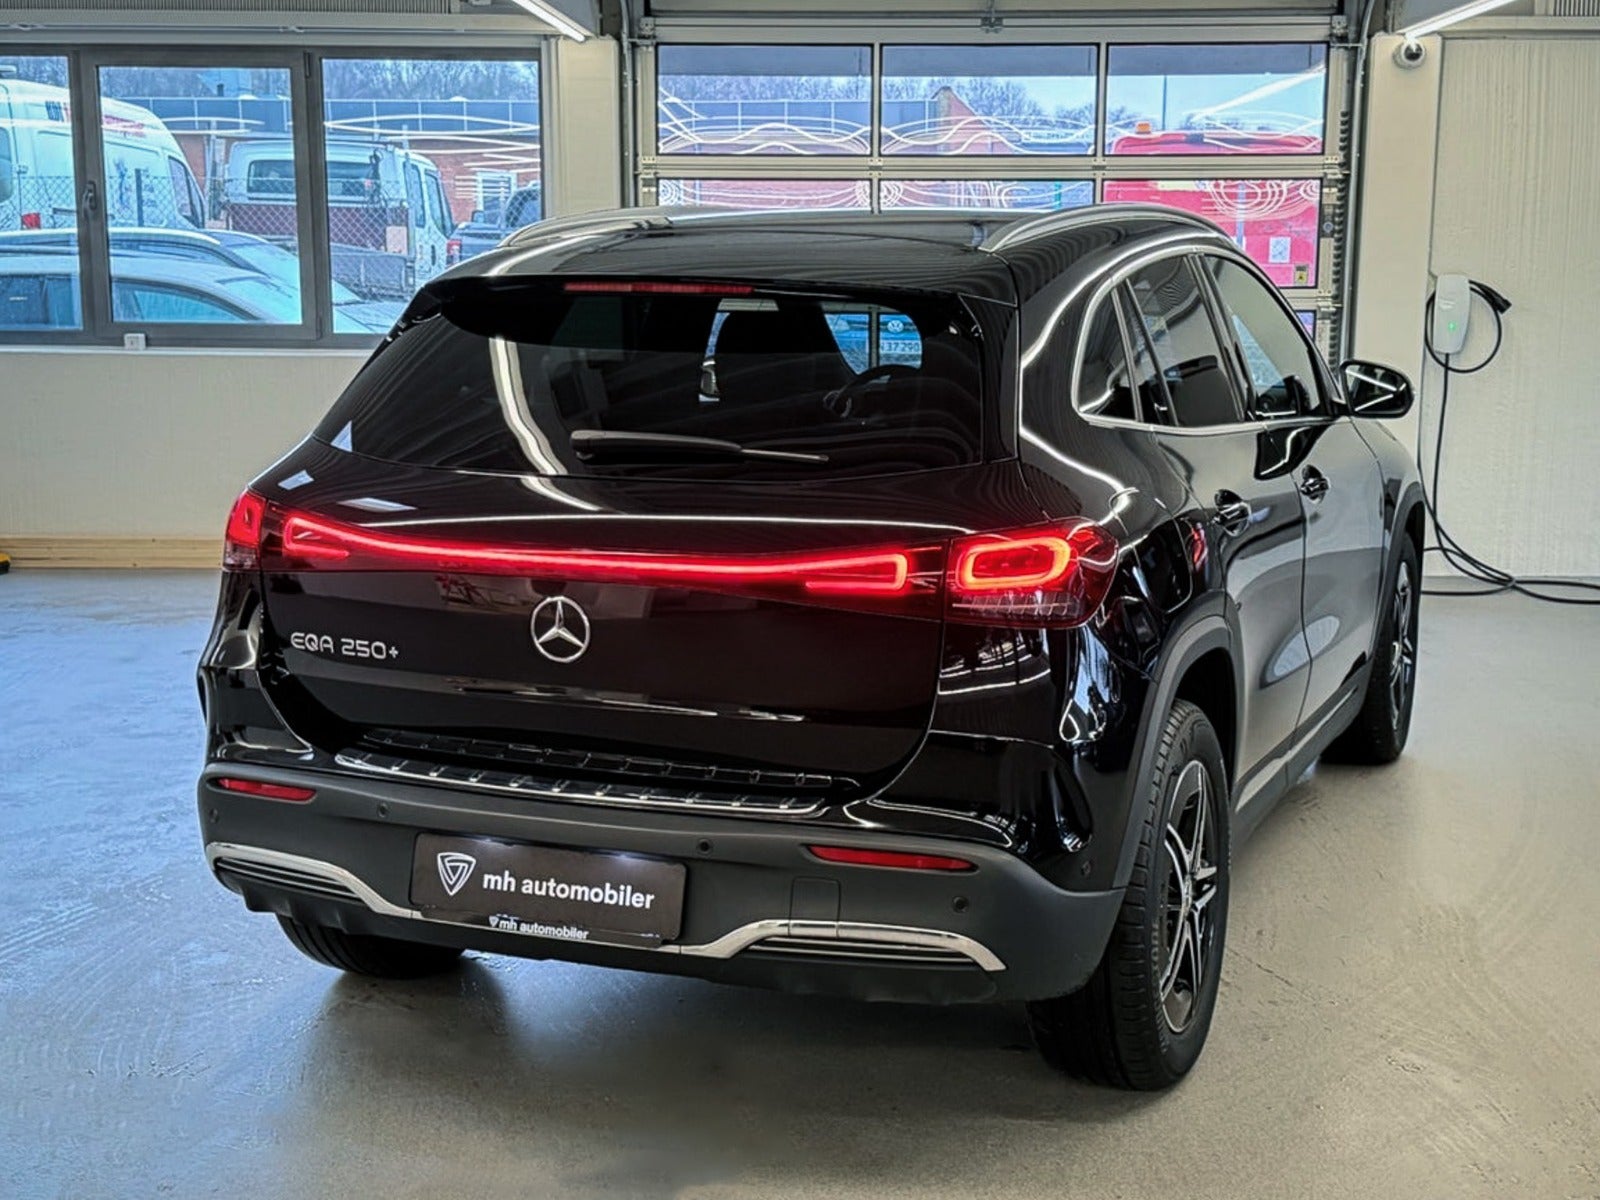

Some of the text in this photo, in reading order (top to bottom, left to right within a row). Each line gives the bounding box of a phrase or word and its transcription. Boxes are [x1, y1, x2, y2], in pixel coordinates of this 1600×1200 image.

[290, 632, 399, 659] EQA 250+
[483, 870, 655, 909] mh automobiler
[520, 922, 589, 939] automobiler
